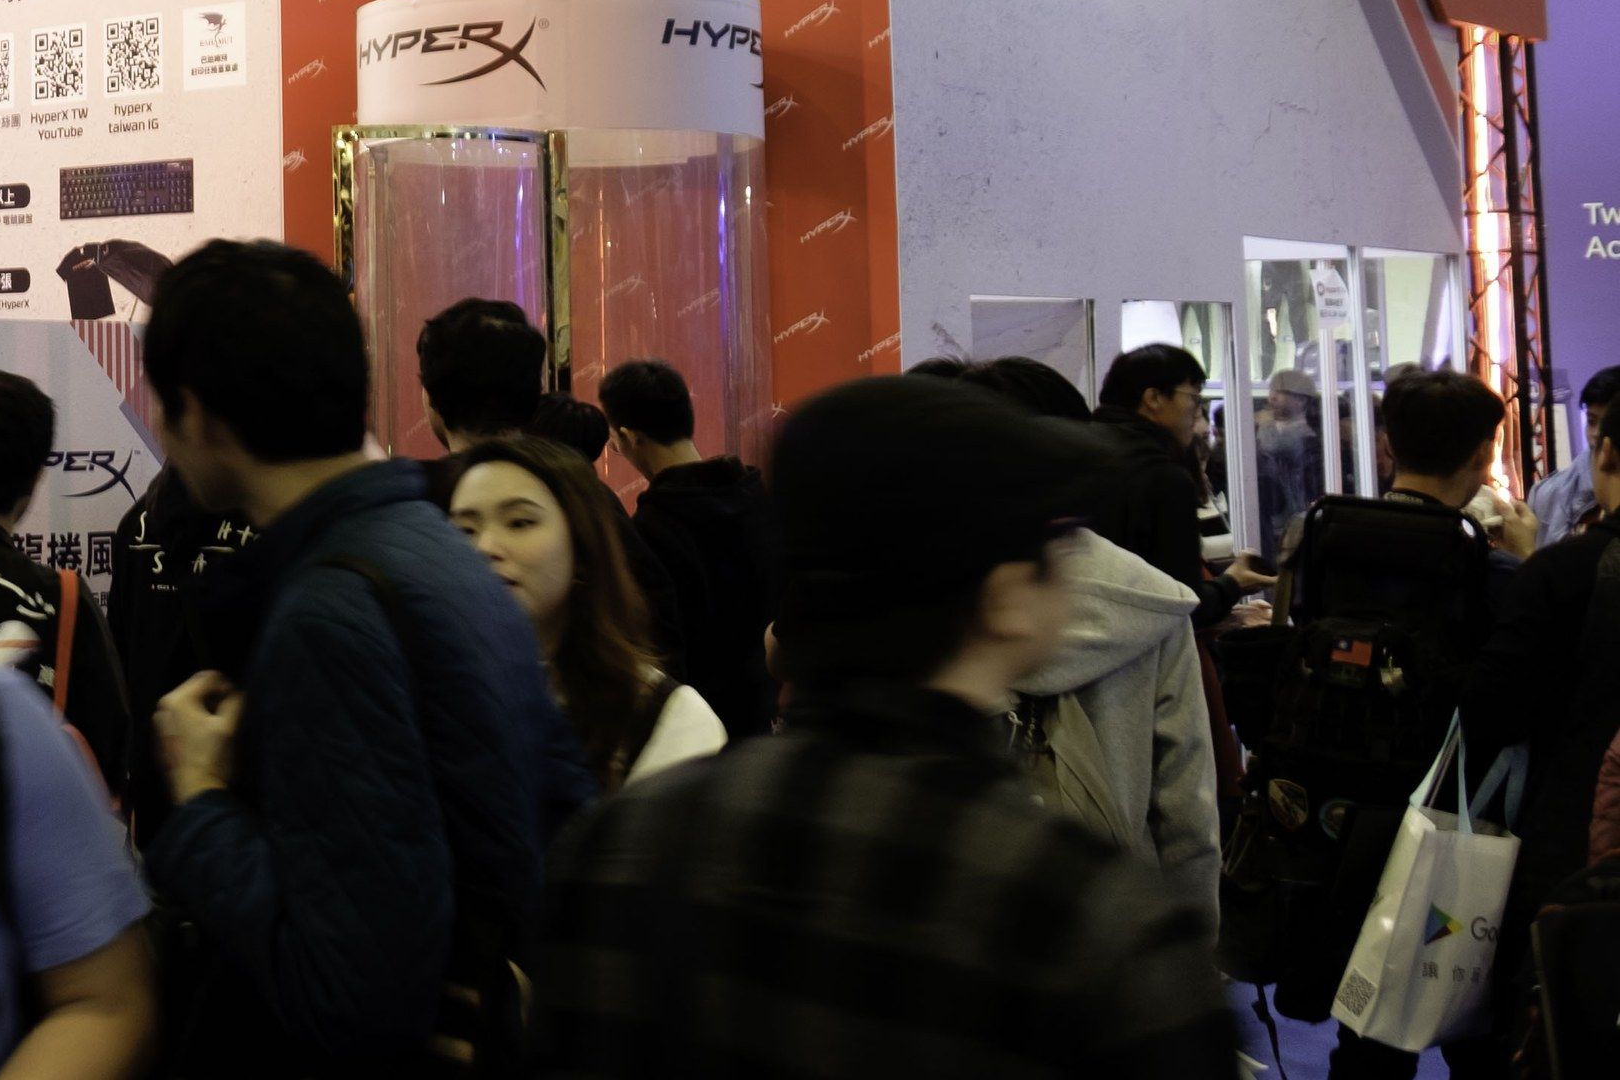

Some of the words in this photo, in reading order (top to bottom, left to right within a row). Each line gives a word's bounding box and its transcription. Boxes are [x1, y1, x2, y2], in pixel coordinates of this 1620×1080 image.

[662, 18, 763, 60] HYPE
[359, 16, 547, 92] HYPERX
[30, 111, 69, 126] HyperX
[71, 108, 88, 120] TW
[113, 103, 153, 117] hyperx
[38, 126, 84, 141] YouTube
[108, 120, 146, 134] taiwan
[148, 119, 159, 131] IG
[43, 449, 138, 505] PERX
